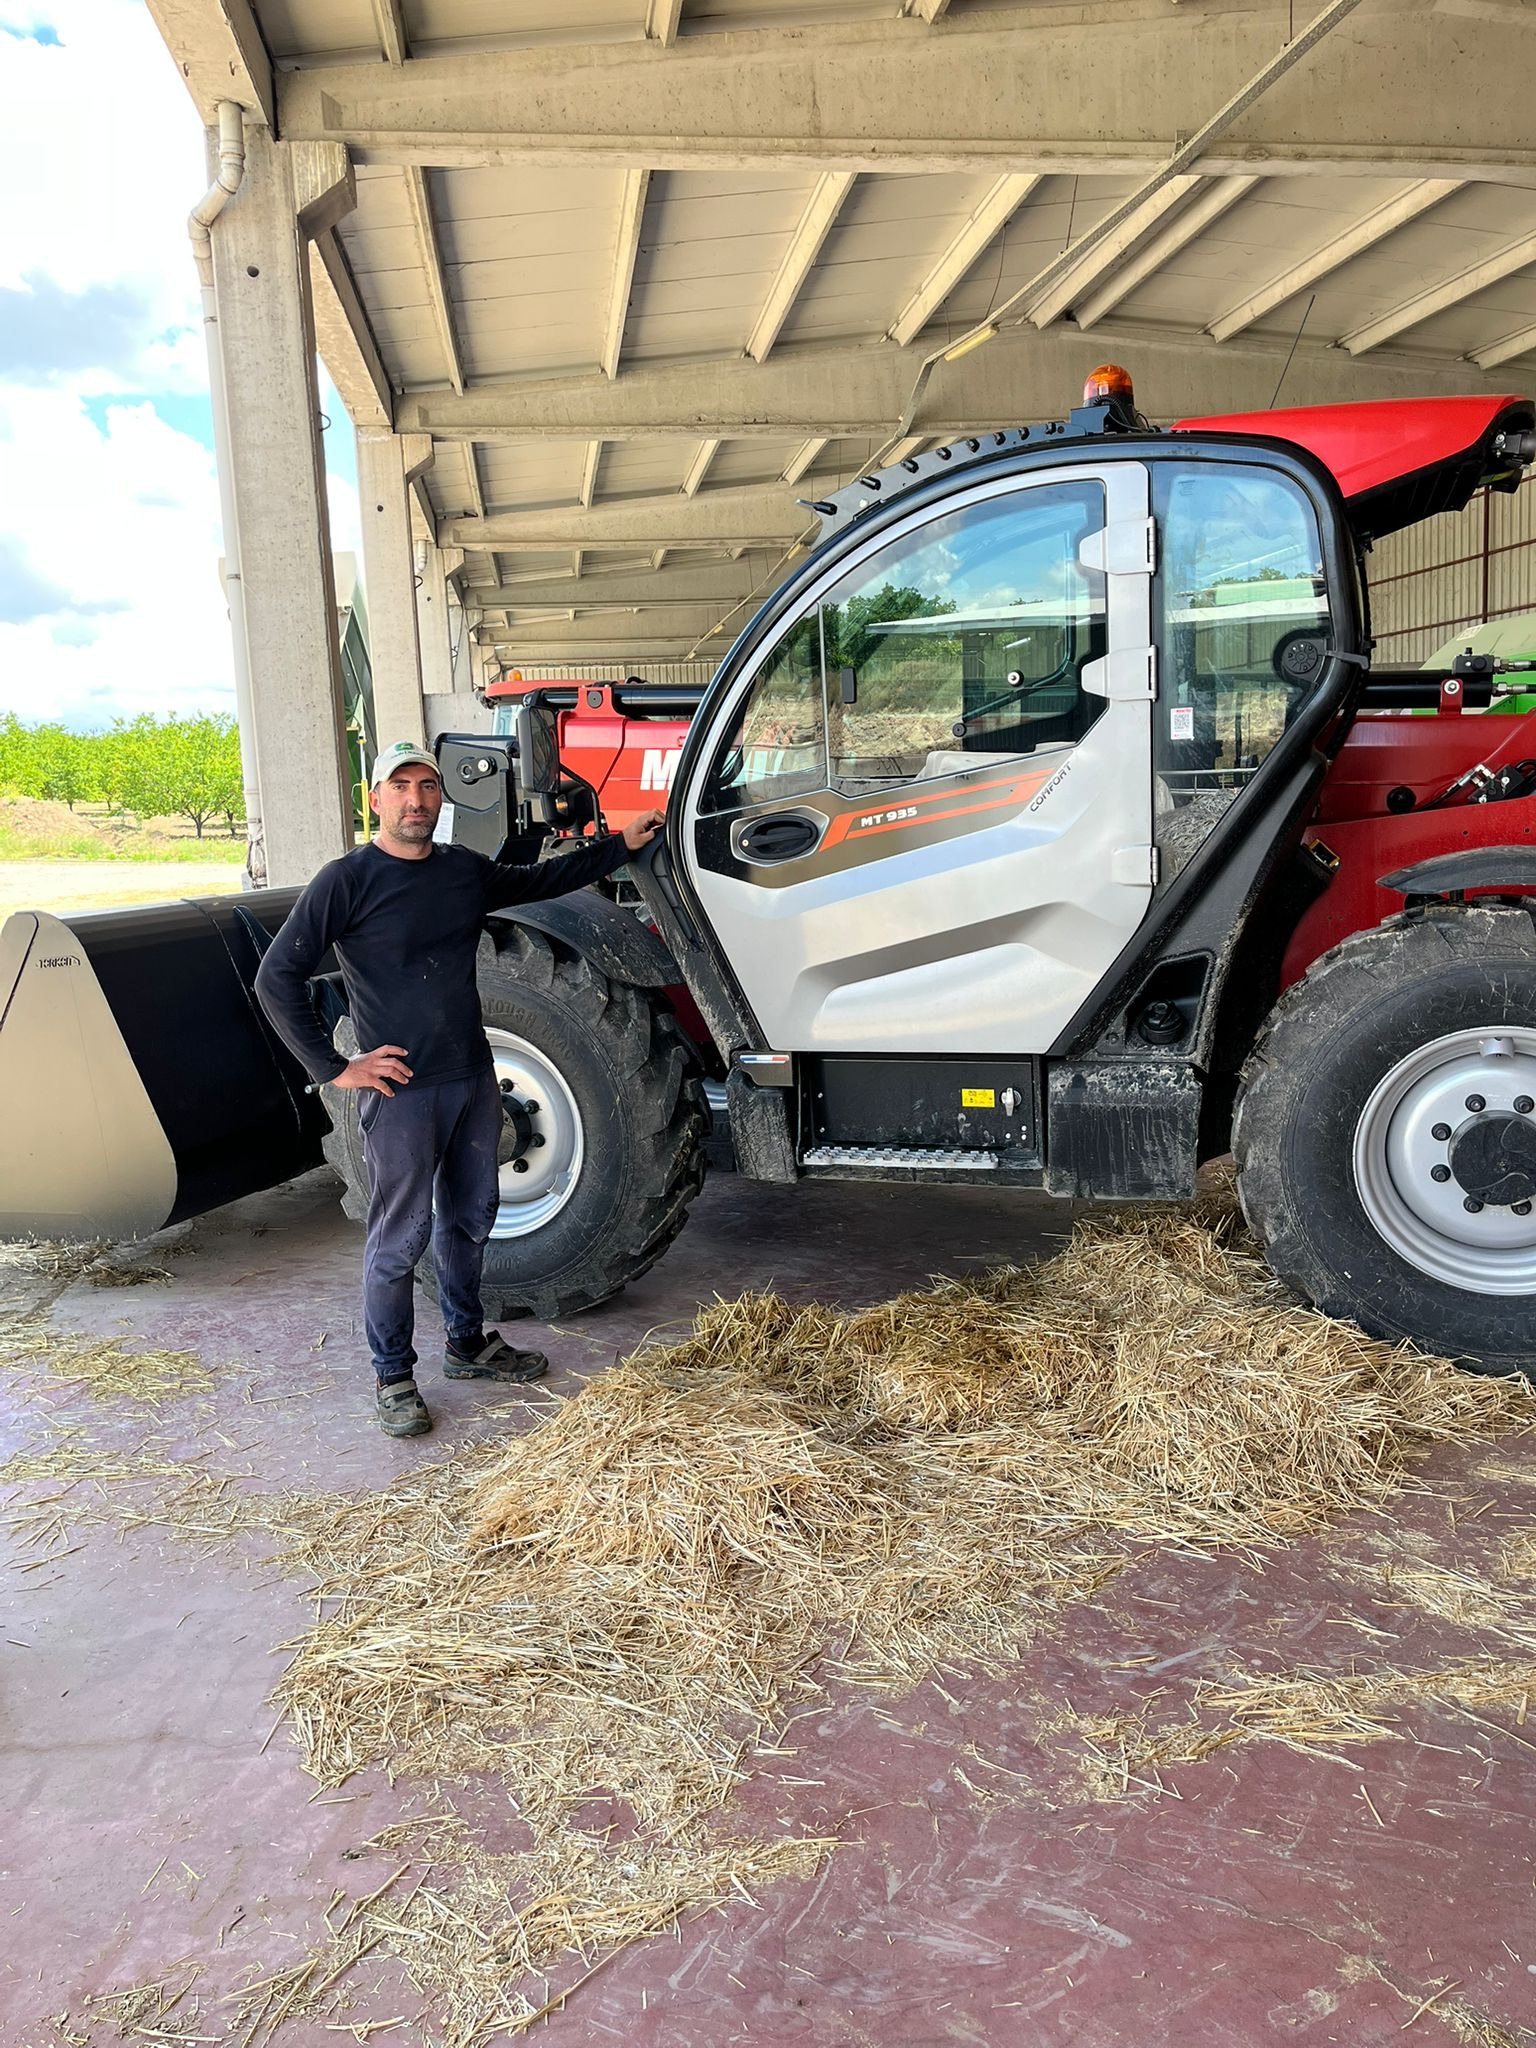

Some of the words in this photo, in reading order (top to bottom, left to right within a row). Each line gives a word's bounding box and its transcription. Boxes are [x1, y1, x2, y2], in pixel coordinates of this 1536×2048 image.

[1030, 761, 1071, 812] COMFORT
[861, 813, 884, 827] MT
[886, 806, 918, 822] 935
